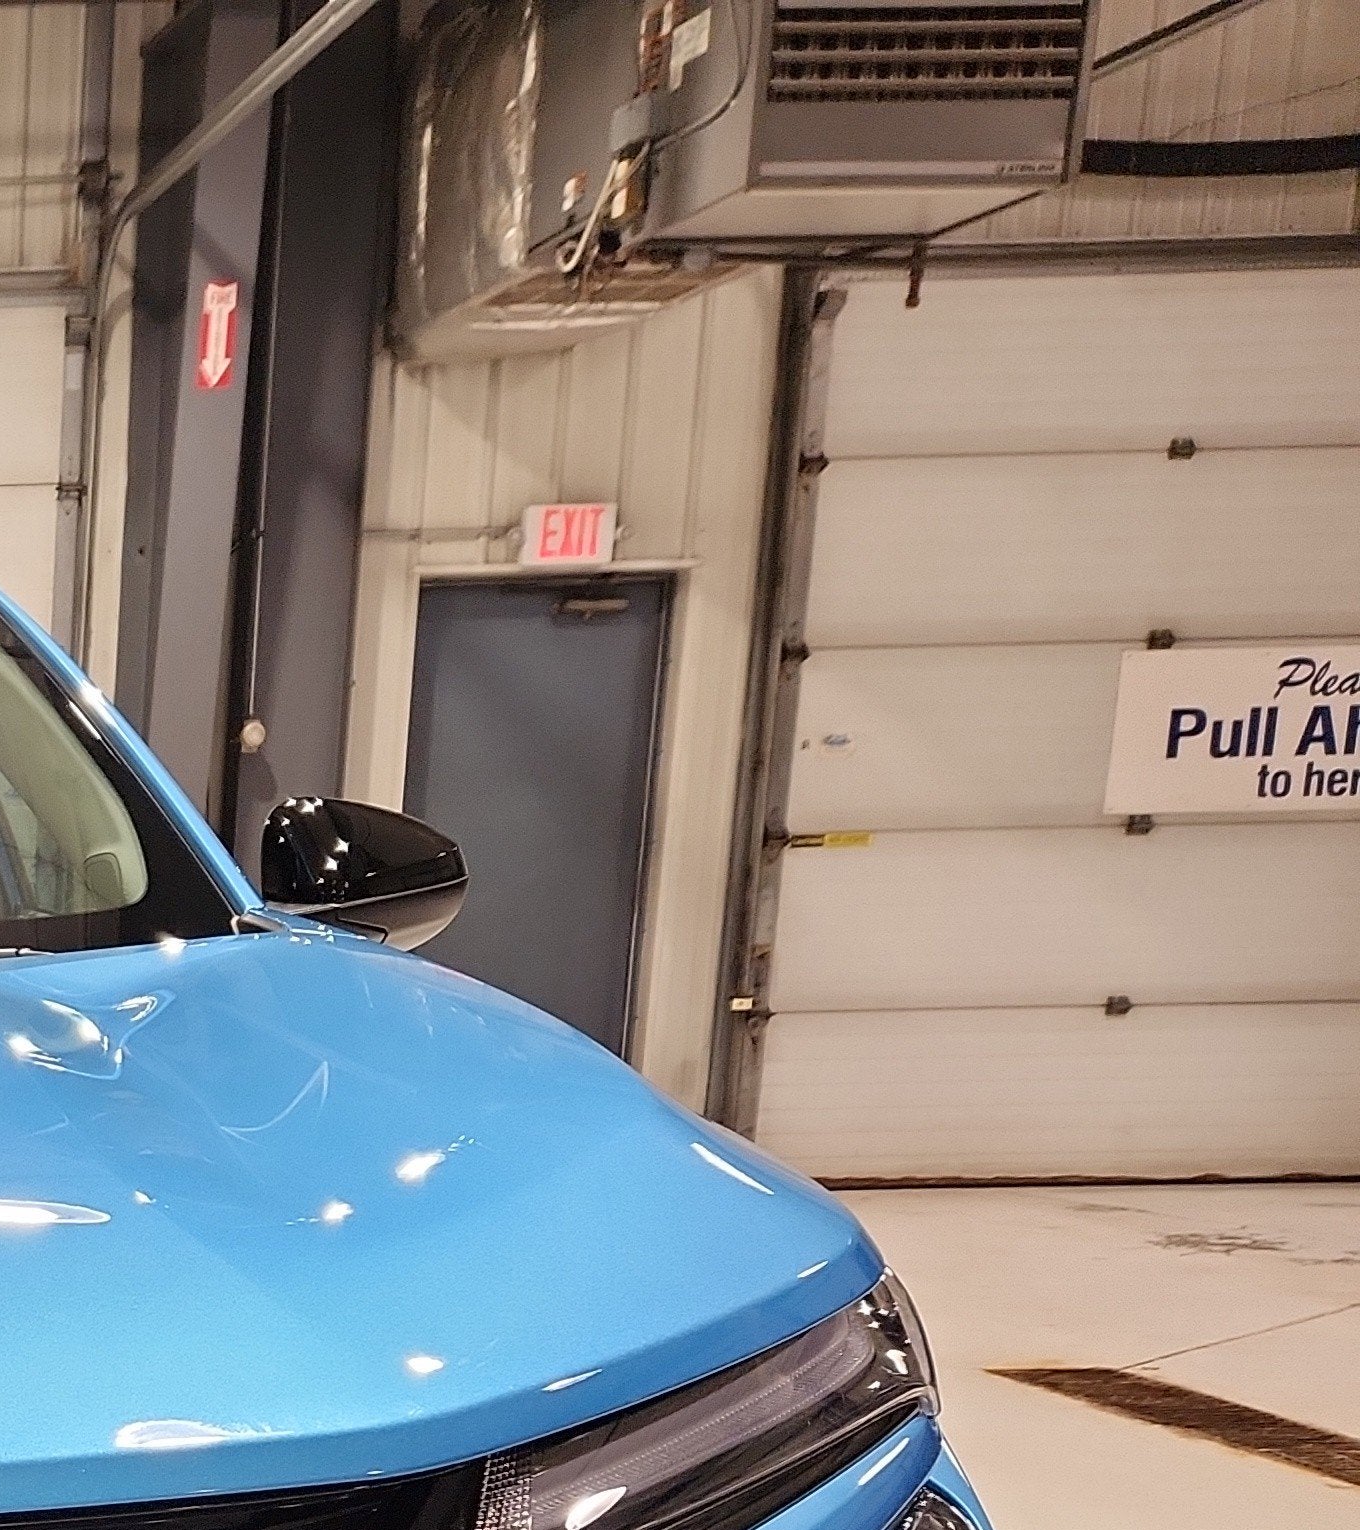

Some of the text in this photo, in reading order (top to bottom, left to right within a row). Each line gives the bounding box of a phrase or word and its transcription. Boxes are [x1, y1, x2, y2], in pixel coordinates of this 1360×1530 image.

[539, 508, 606, 557] EXIT
[1165, 705, 1280, 759] Pull
[1256, 763, 1293, 798] to
